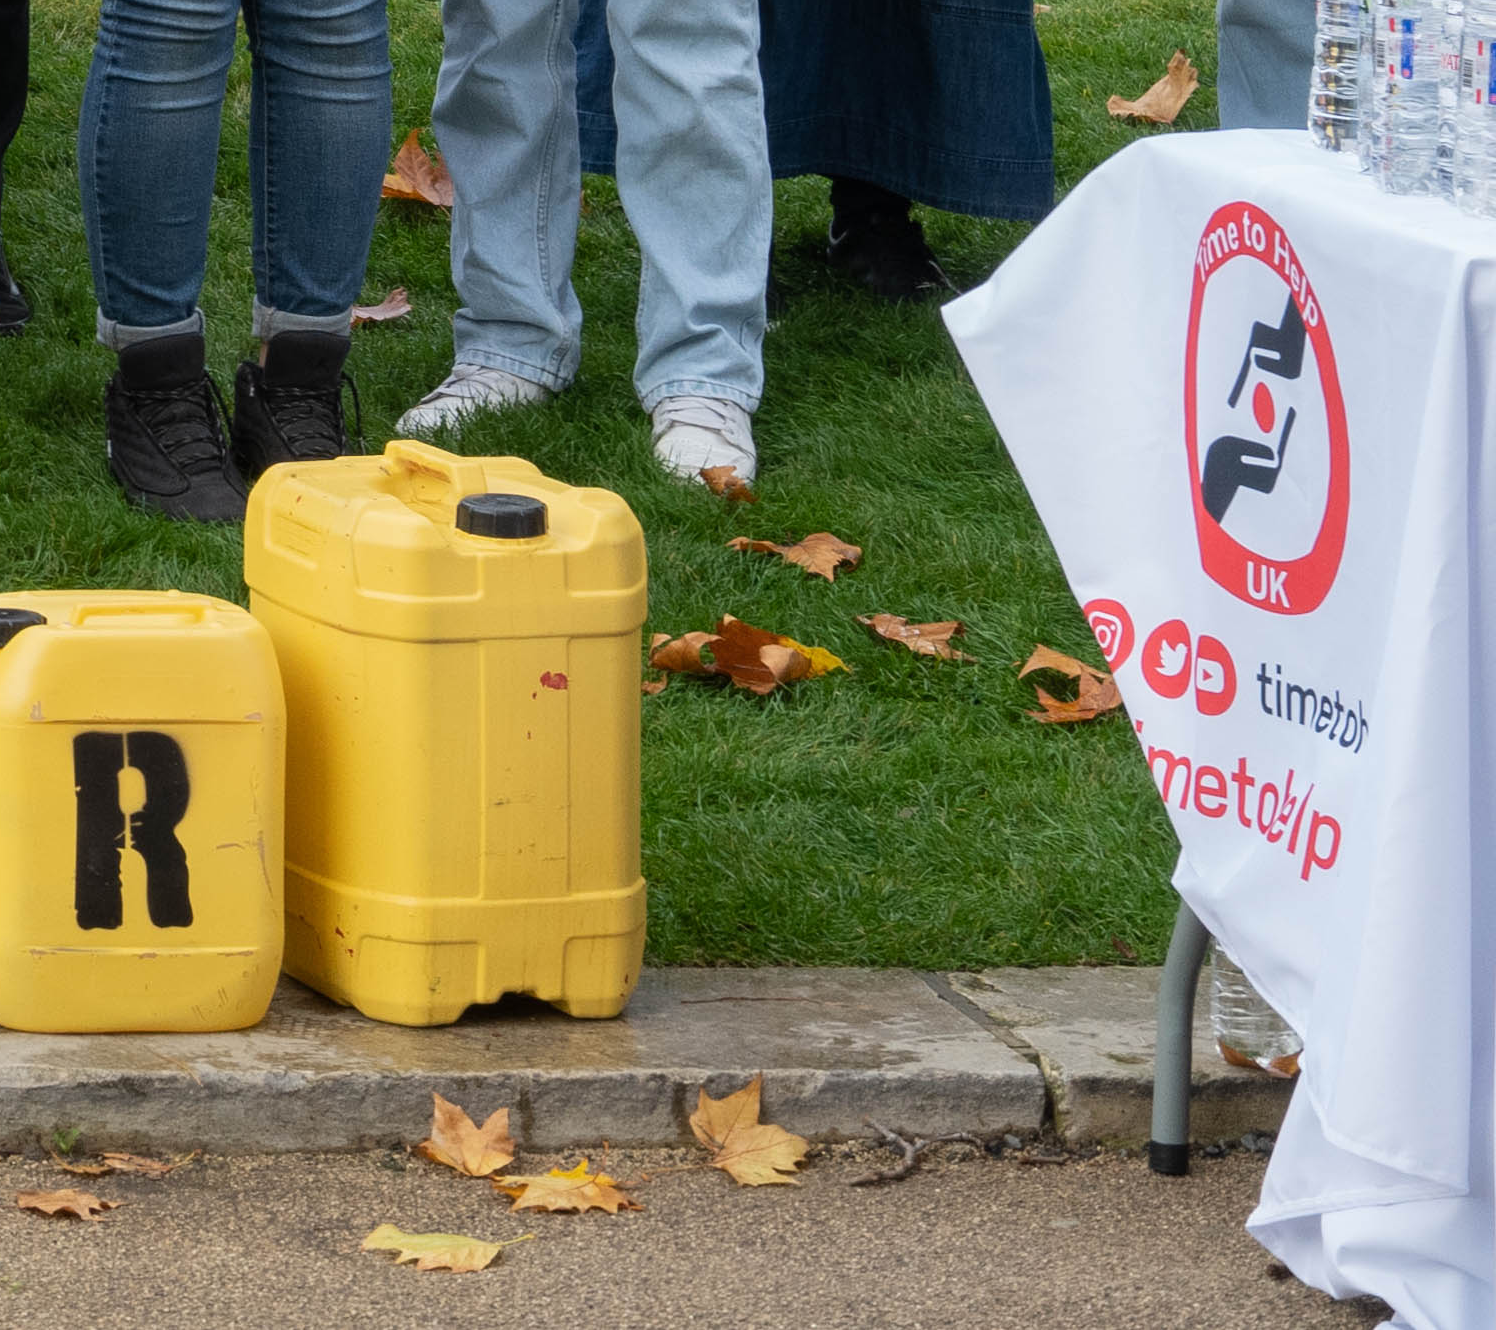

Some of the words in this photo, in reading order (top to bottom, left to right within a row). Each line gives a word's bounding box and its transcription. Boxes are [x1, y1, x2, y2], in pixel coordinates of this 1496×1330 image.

[1197, 218, 1240, 284] Time
[1242, 210, 1269, 253] to
[1272, 230, 1320, 329] Help
[1245, 561, 1291, 610] UK
